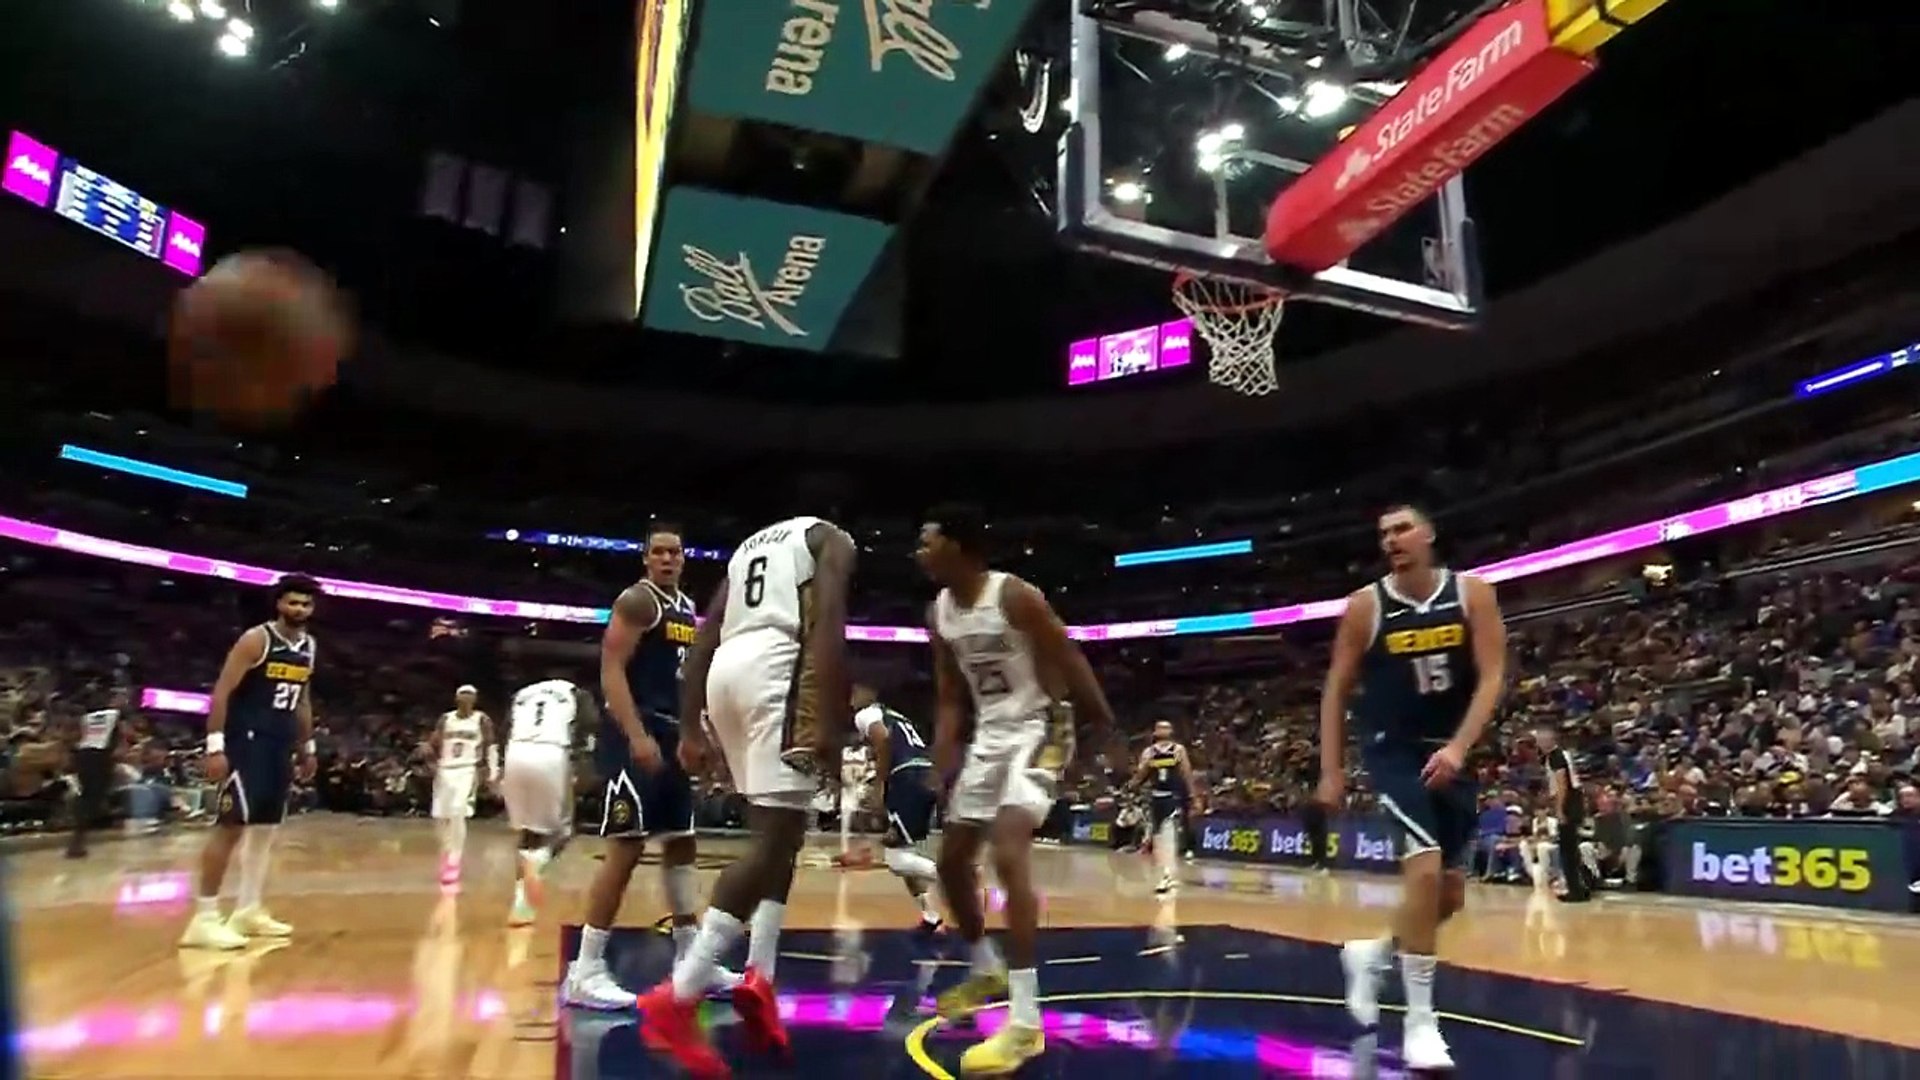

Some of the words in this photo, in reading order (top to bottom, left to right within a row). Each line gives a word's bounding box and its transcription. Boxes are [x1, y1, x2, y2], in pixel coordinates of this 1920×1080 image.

[766, 0, 839, 95] rena
[679, 243, 767, 330] Ball
[762, 235, 827, 307] Arena
[744, 555, 768, 609] 6
[273, 682, 302, 711] 27
[1411, 653, 1452, 694] 15
[1202, 826, 1260, 853] bet365
[1271, 829, 1340, 858] bet5
[1692, 841, 1871, 890] bet365
